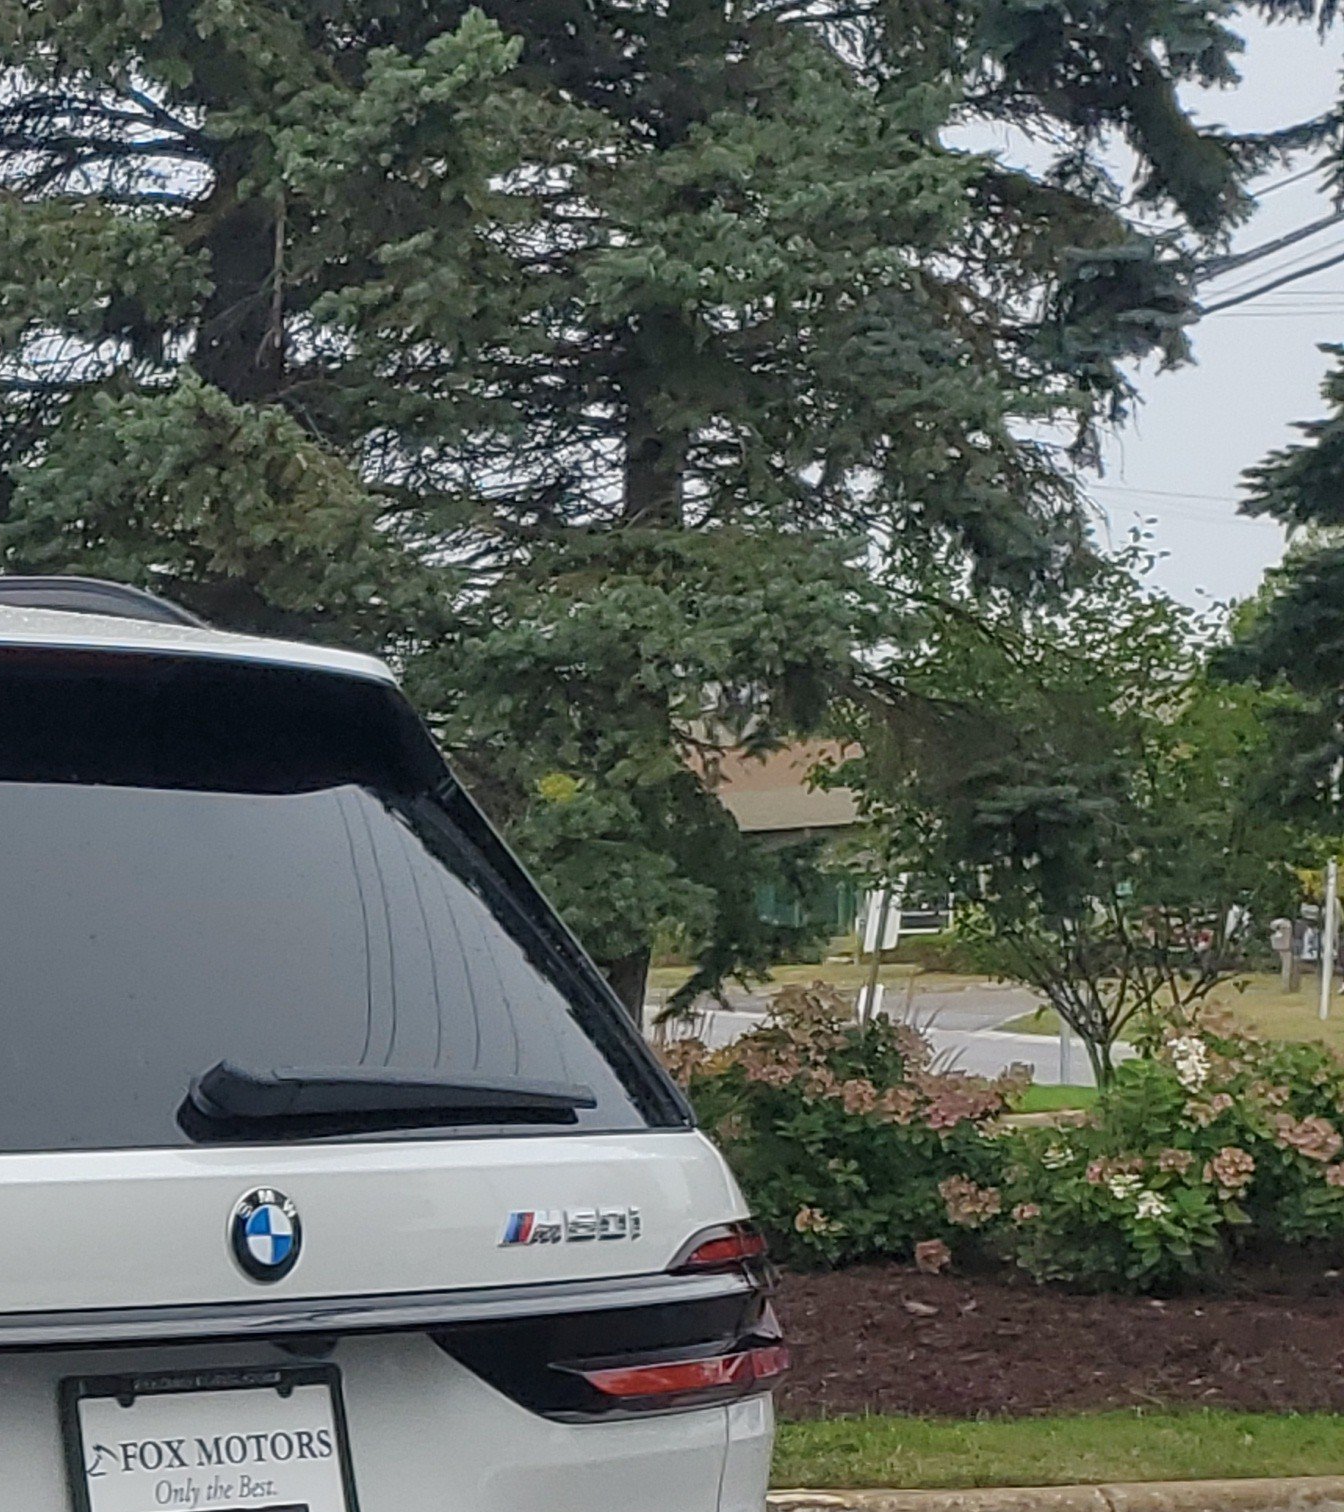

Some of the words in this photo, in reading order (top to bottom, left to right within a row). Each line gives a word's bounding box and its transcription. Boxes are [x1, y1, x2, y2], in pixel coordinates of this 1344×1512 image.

[120, 1438, 189, 1472] FOX
[194, 1429, 333, 1467] MOTORS
[155, 1477, 201, 1509] Only
[206, 1475, 234, 1501] the
